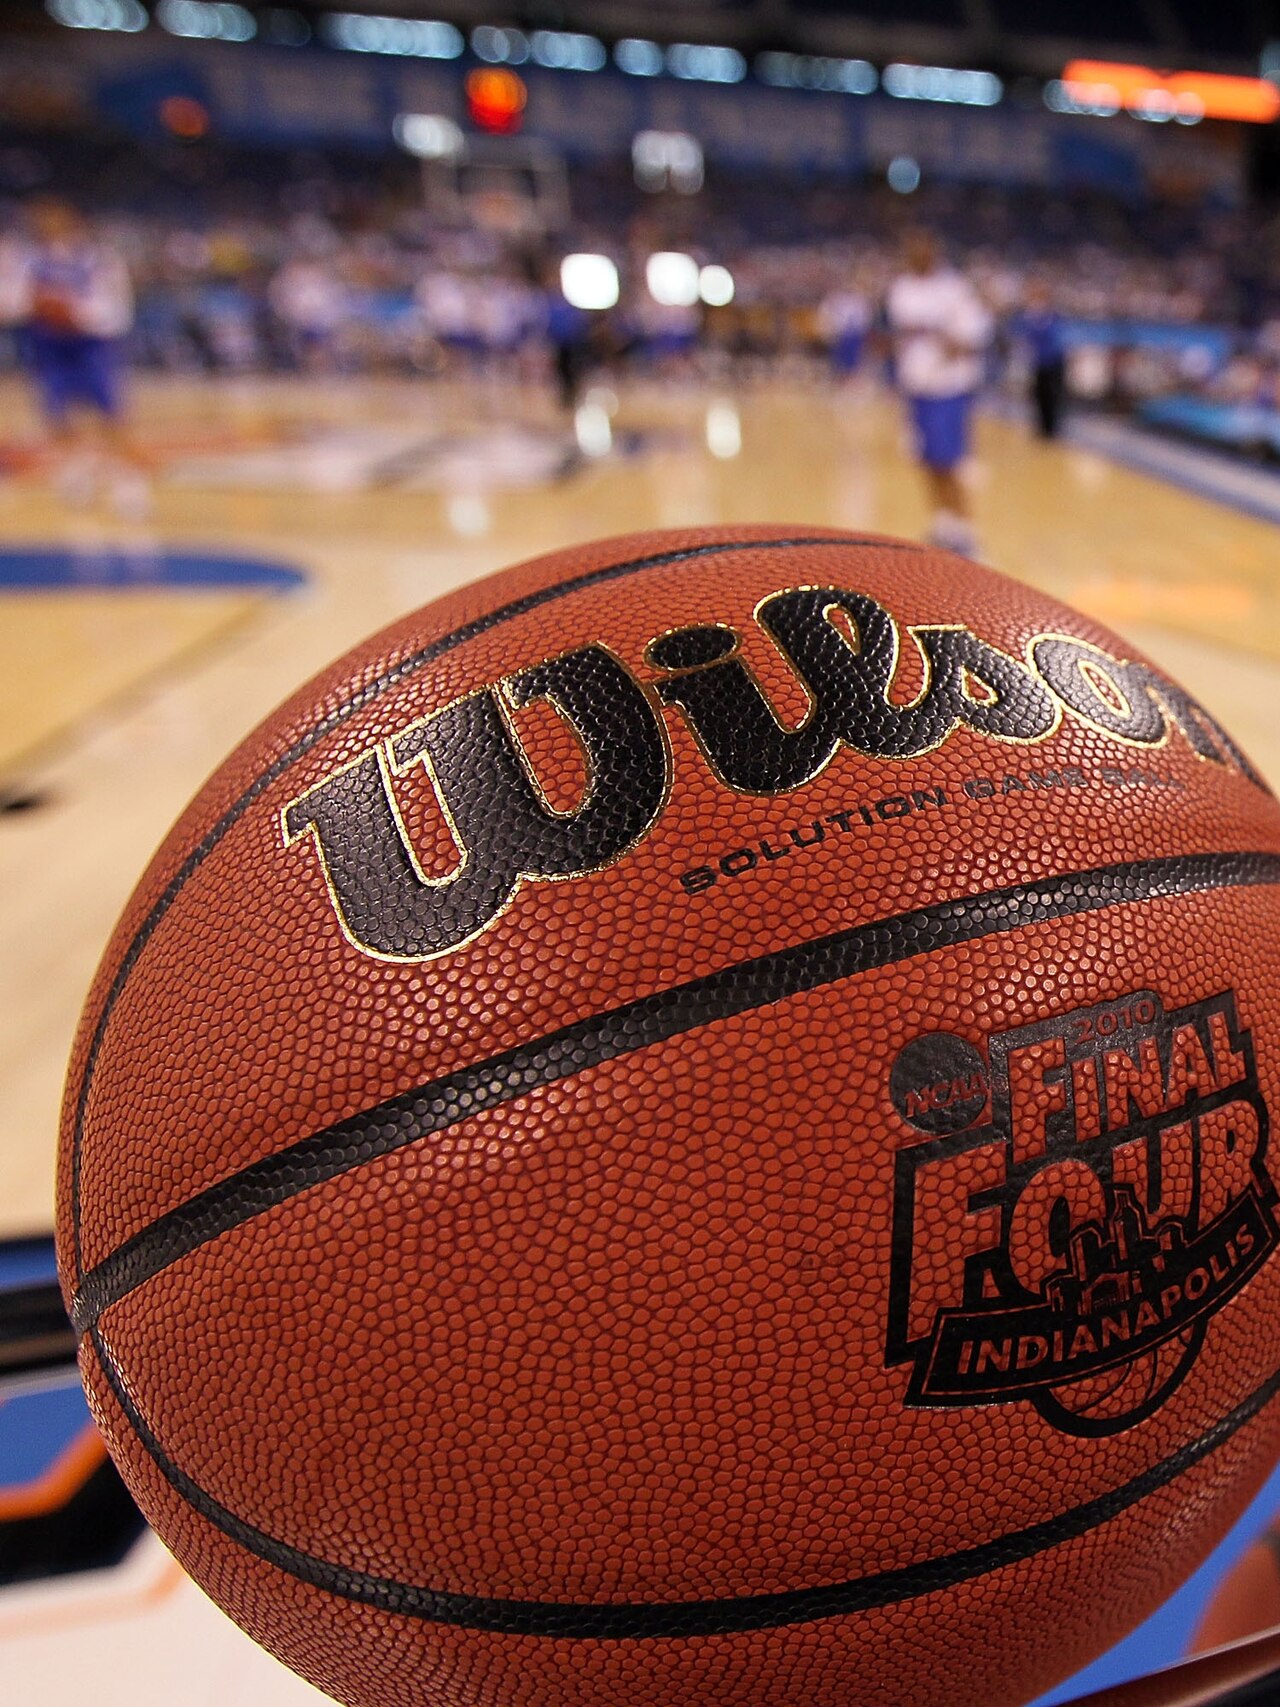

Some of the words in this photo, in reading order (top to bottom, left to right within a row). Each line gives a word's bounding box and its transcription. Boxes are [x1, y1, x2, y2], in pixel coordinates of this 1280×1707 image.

[281, 584, 1272, 963] Wilson
[679, 785, 949, 896] SOLUTION
[963, 766, 1088, 800] GAME
[905, 1072, 989, 1119] NCAA
[1008, 1010, 1248, 1165] FINAL
[1074, 998, 1157, 1045] 2010
[905, 1099, 1264, 1343] FOUR
[956, 1222, 1257, 1376] INDIANAPOLIS
